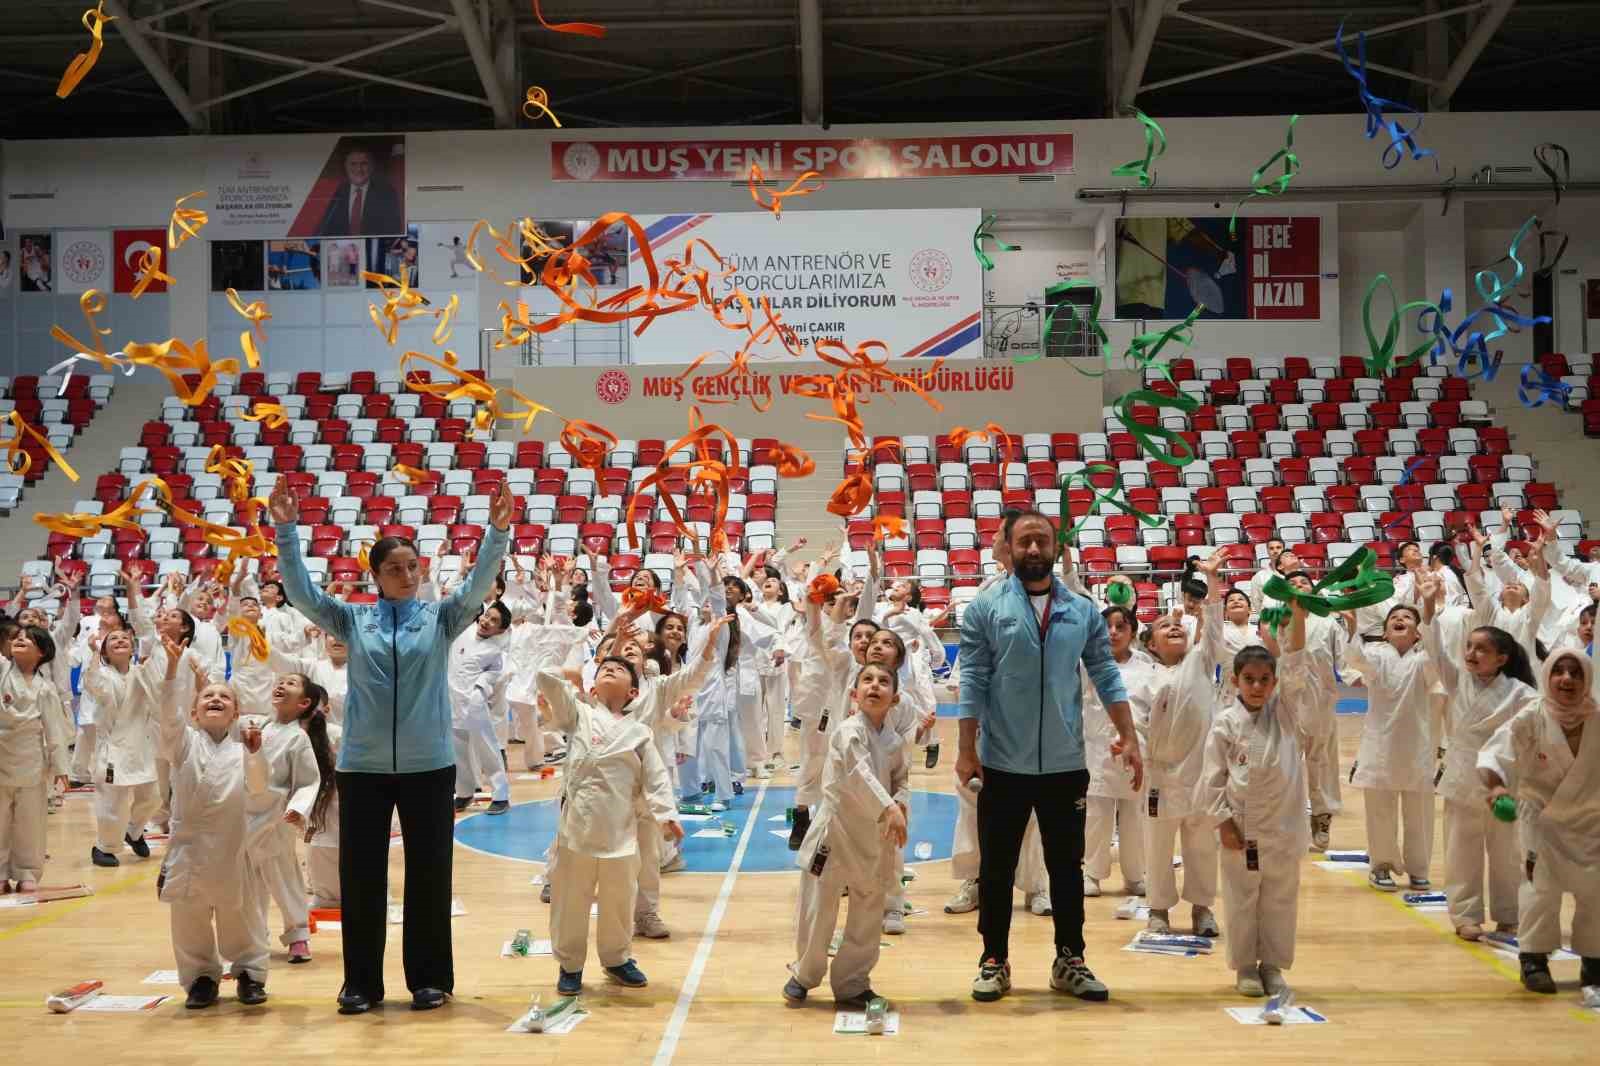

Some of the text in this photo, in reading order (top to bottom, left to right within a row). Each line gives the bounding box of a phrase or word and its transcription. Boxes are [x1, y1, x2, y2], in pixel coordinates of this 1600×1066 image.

[607, 142, 1055, 178] MUŞ YENİ SPO SALONU
[719, 251, 892, 271] TÜM ANTRENÖR VE
[723, 273, 886, 291] SPORCULARIMIZA
[713, 293, 896, 313] BAŞALAR DİLİYORUM
[643, 376, 684, 401] MUŞ
[692, 371, 770, 400] GENÇLİK
[779, 374, 802, 395] V
[893, 366, 1014, 393] MÜDÜRLÜĞÜ
